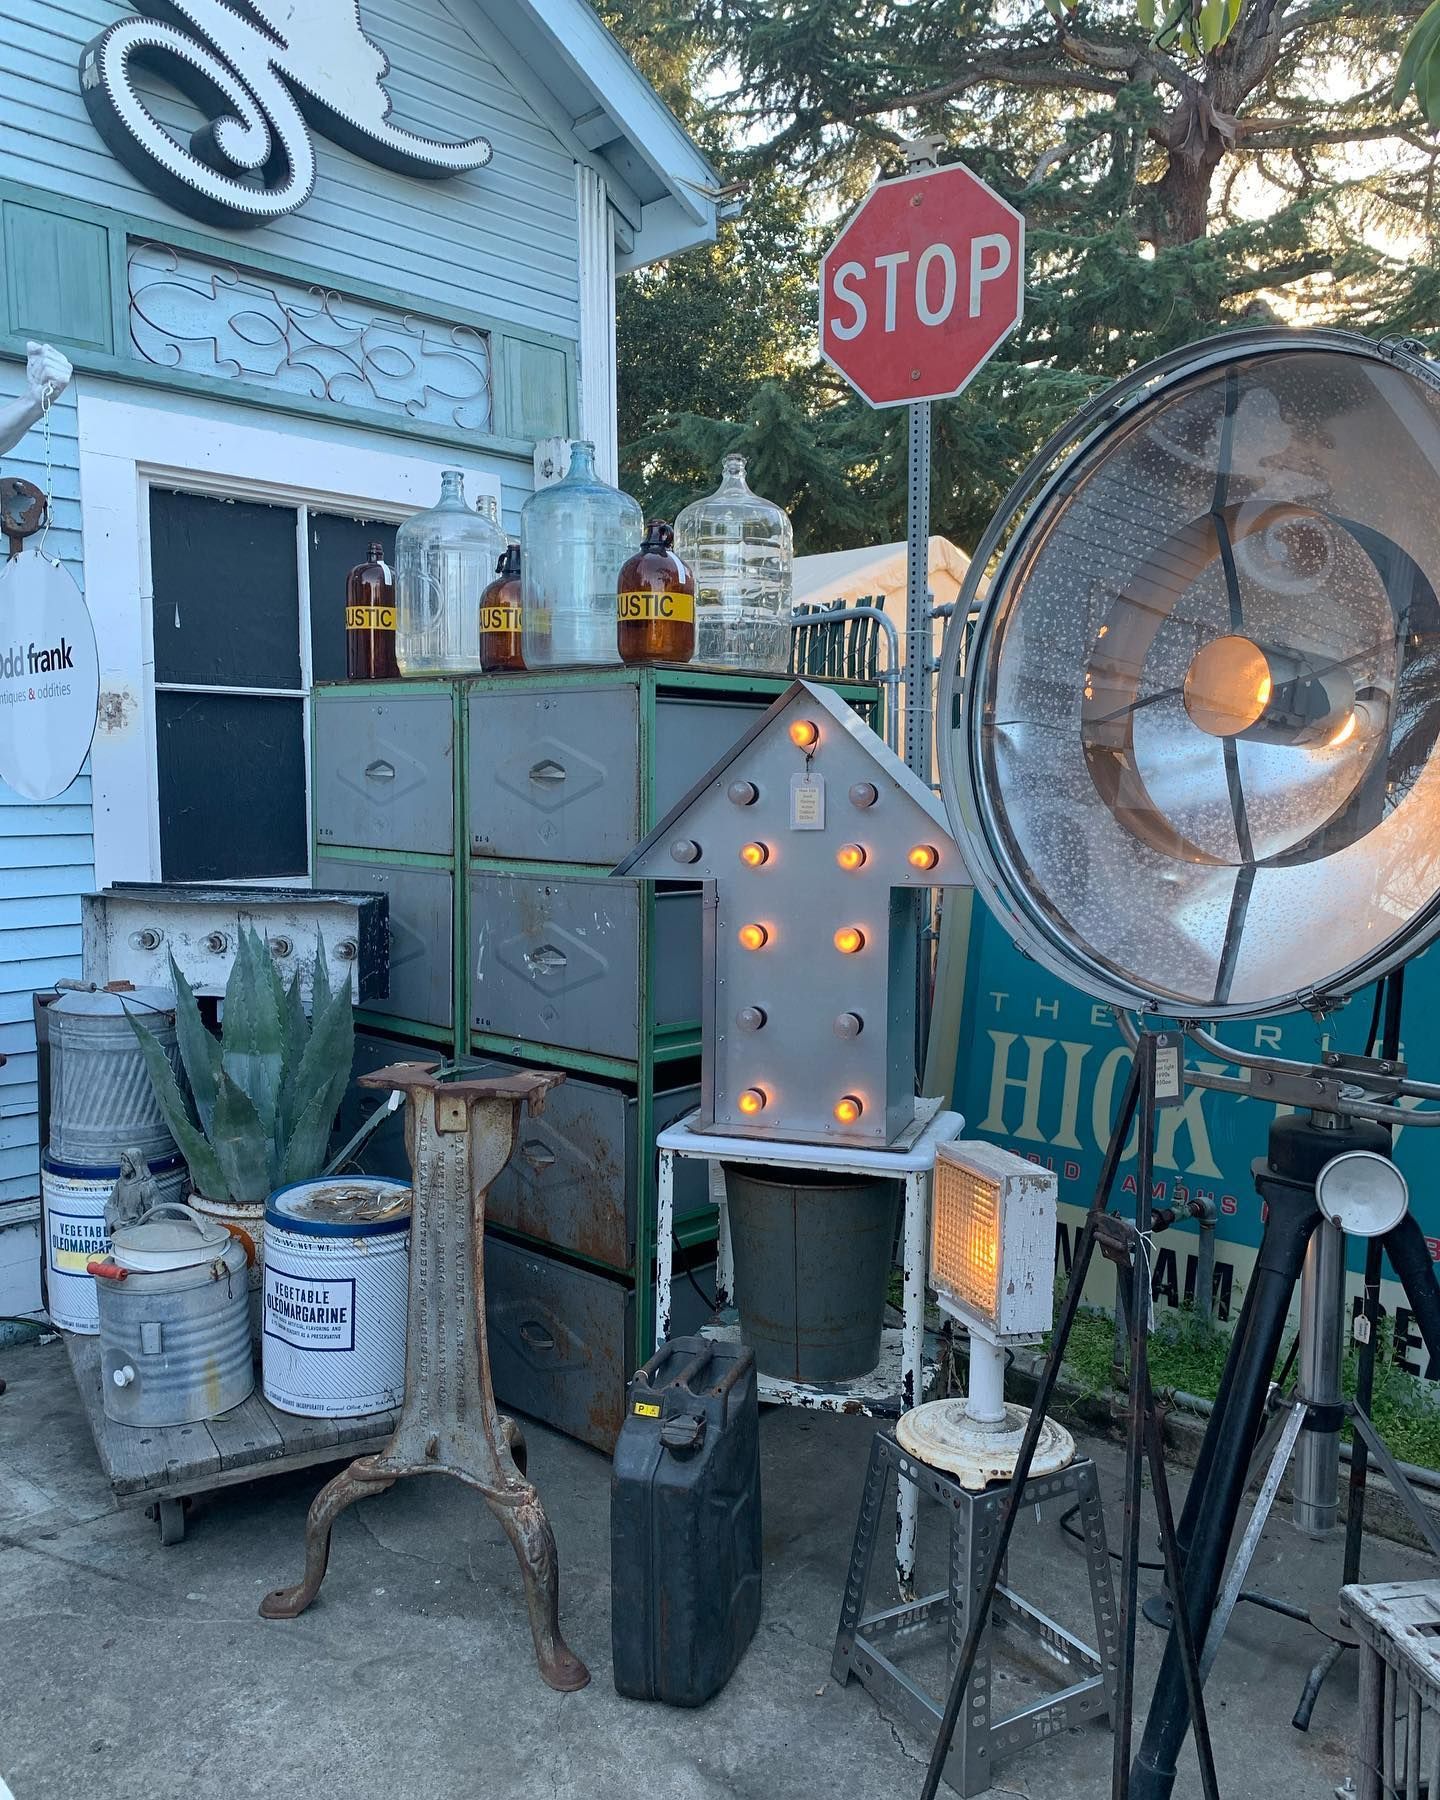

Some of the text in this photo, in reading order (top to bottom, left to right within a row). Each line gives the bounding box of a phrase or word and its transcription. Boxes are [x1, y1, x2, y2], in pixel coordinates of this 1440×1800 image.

[830, 232, 1012, 341] STOP
[347, 608, 392, 627] USTIC
[27, 637, 74, 675] frank
[28, 687, 36, 701] &
[37, 682, 72, 700] oddities
[59, 1222, 110, 1238] VEGETABL
[297, 1242, 312, 1251] NET
[316, 1244, 332, 1252] WT.
[274, 1281, 330, 1305] VEGETABLE
[266, 1292, 347, 1324] OLEOMARGARINE
